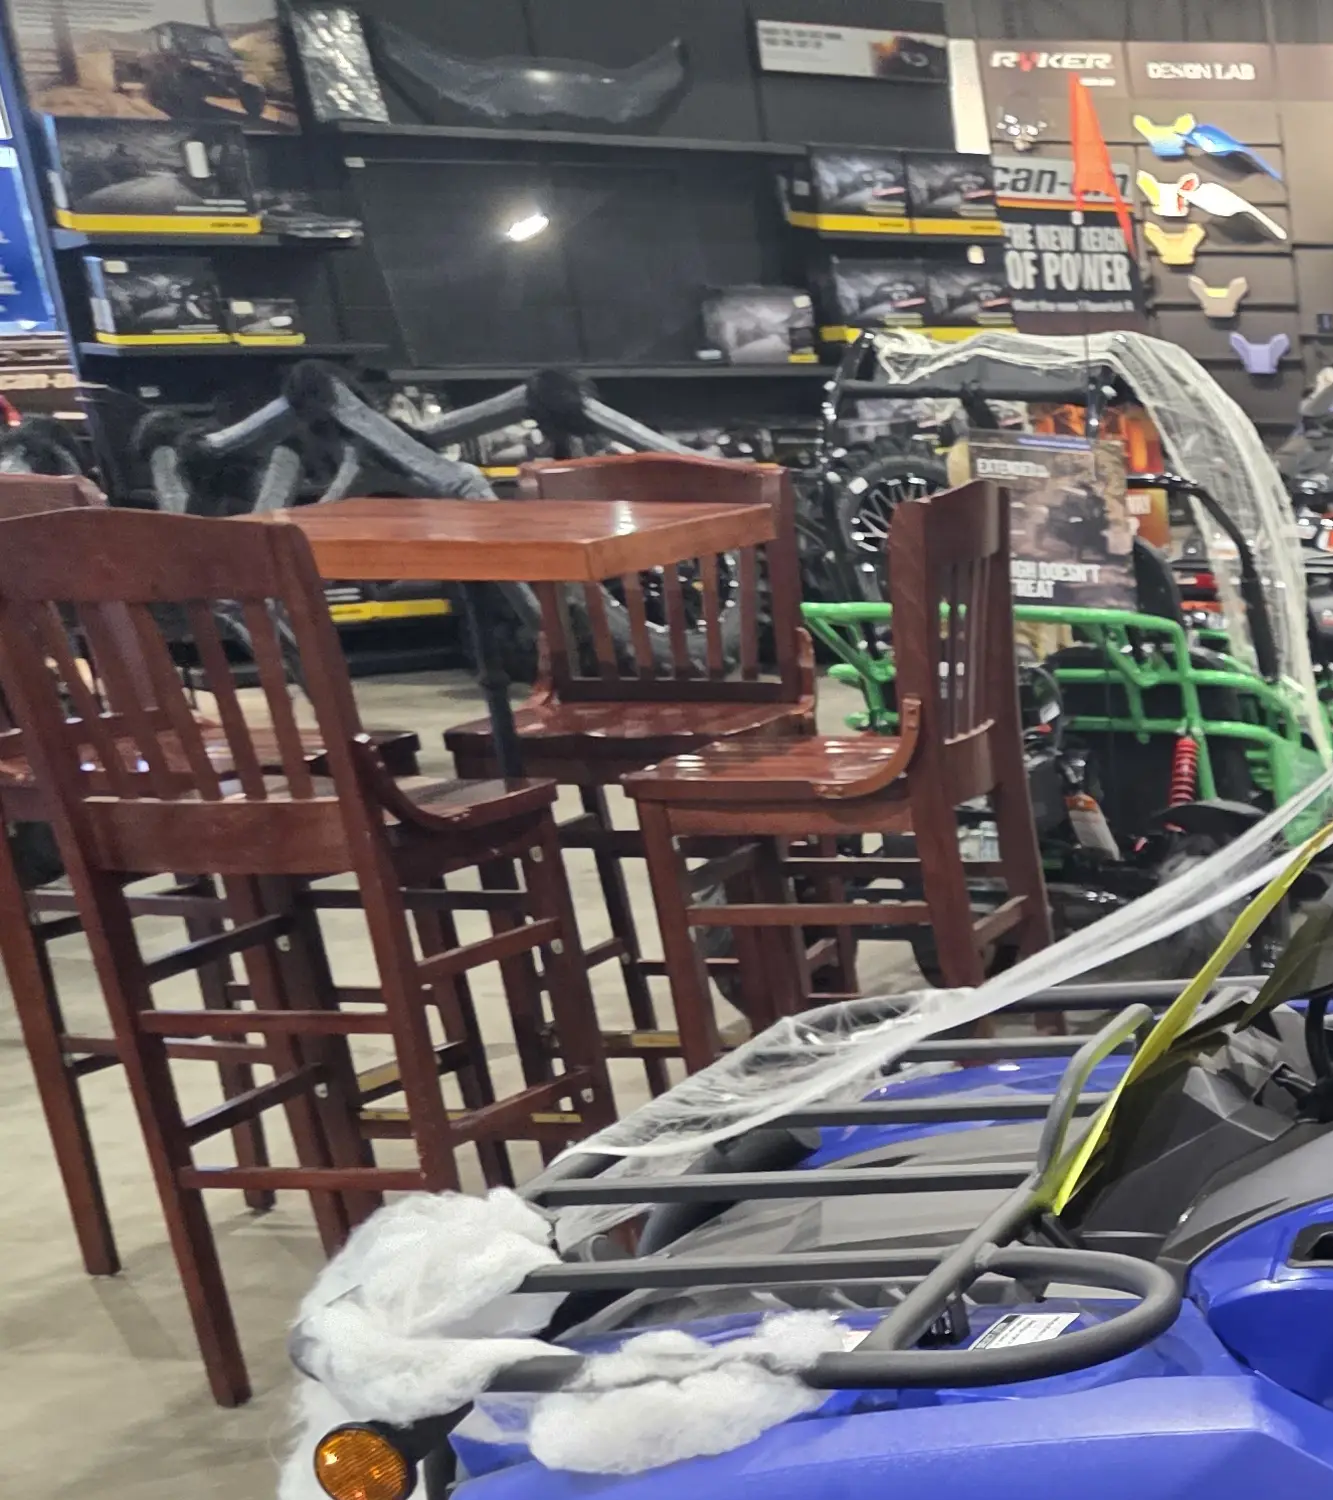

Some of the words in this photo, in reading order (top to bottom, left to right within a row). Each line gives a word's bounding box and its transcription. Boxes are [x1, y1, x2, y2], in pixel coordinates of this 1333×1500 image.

[990, 51, 1115, 72] RYKER
[1214, 63, 1256, 80] LAB
[1035, 224, 1075, 251] NEW
[1005, 250, 1038, 290] OF
[1042, 252, 1132, 291] POWER
